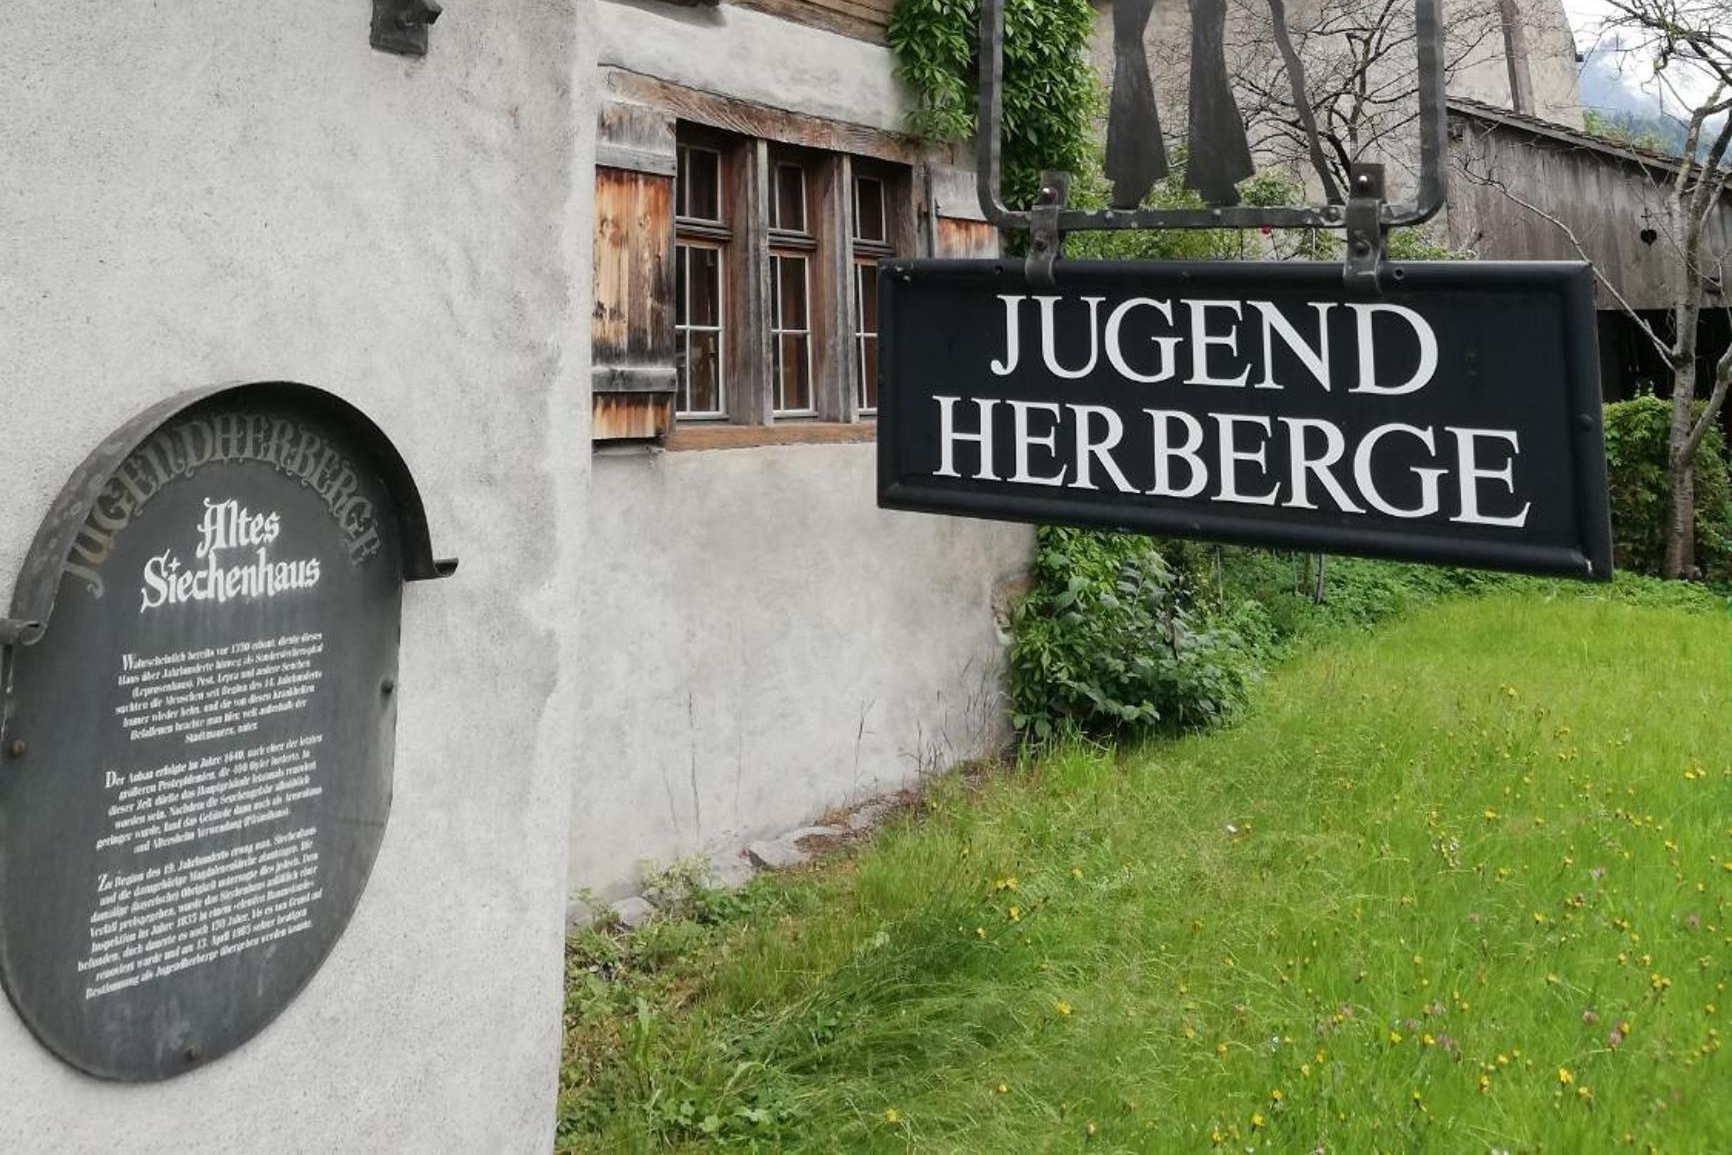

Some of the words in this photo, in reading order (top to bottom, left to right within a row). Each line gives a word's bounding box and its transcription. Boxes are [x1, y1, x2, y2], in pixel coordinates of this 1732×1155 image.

[989, 293, 1439, 396] JUGEND
[63, 413, 382, 599] JUGENDHERBERGE
[931, 394, 1531, 529] HERBERGE
[196, 497, 281, 558] Altes
[140, 547, 321, 614] Siechenhaus
